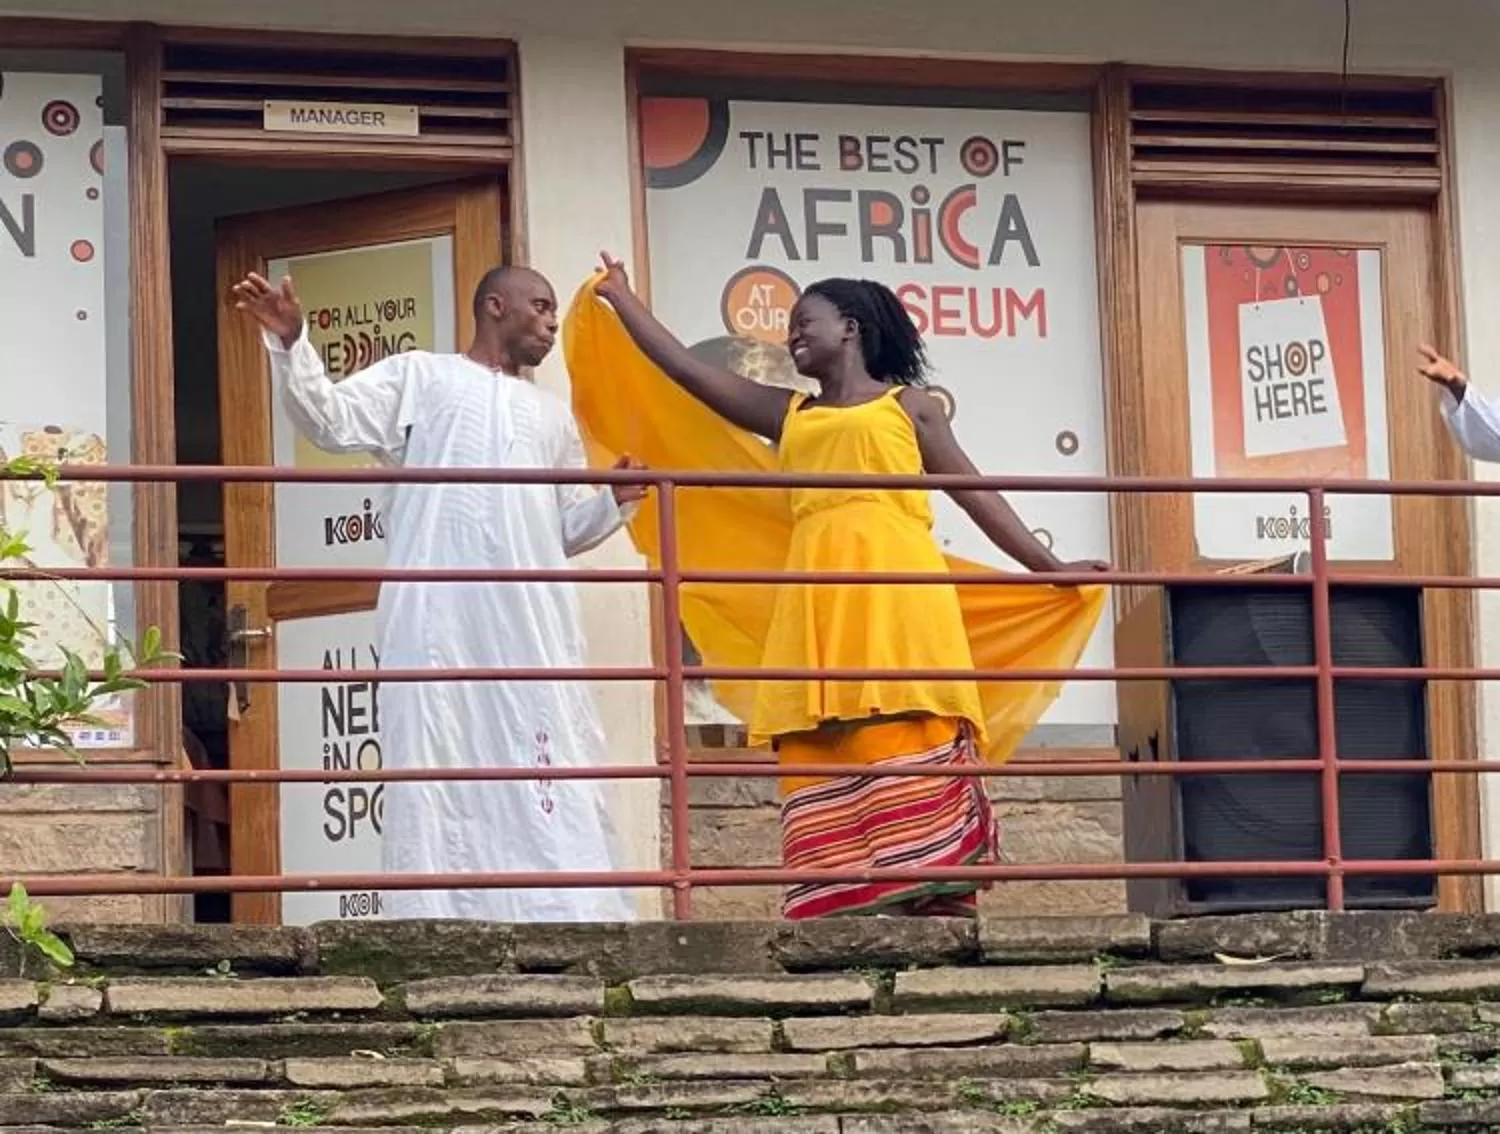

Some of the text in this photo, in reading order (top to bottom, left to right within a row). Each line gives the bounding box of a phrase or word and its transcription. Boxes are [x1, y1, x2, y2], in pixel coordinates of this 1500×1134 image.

[290, 107, 385, 127] MANAGER
[739, 131, 1026, 177] THE BEST OF
[308, 297, 416, 330] FOR ALL YOUR
[750, 283, 774, 307] AT
[896, 281, 1048, 338] SEUM
[736, 306, 787, 331] OUR
[321, 323, 417, 379] EDDiNG
[1246, 339, 1325, 383] SHOP
[1254, 379, 1327, 422] HERE
